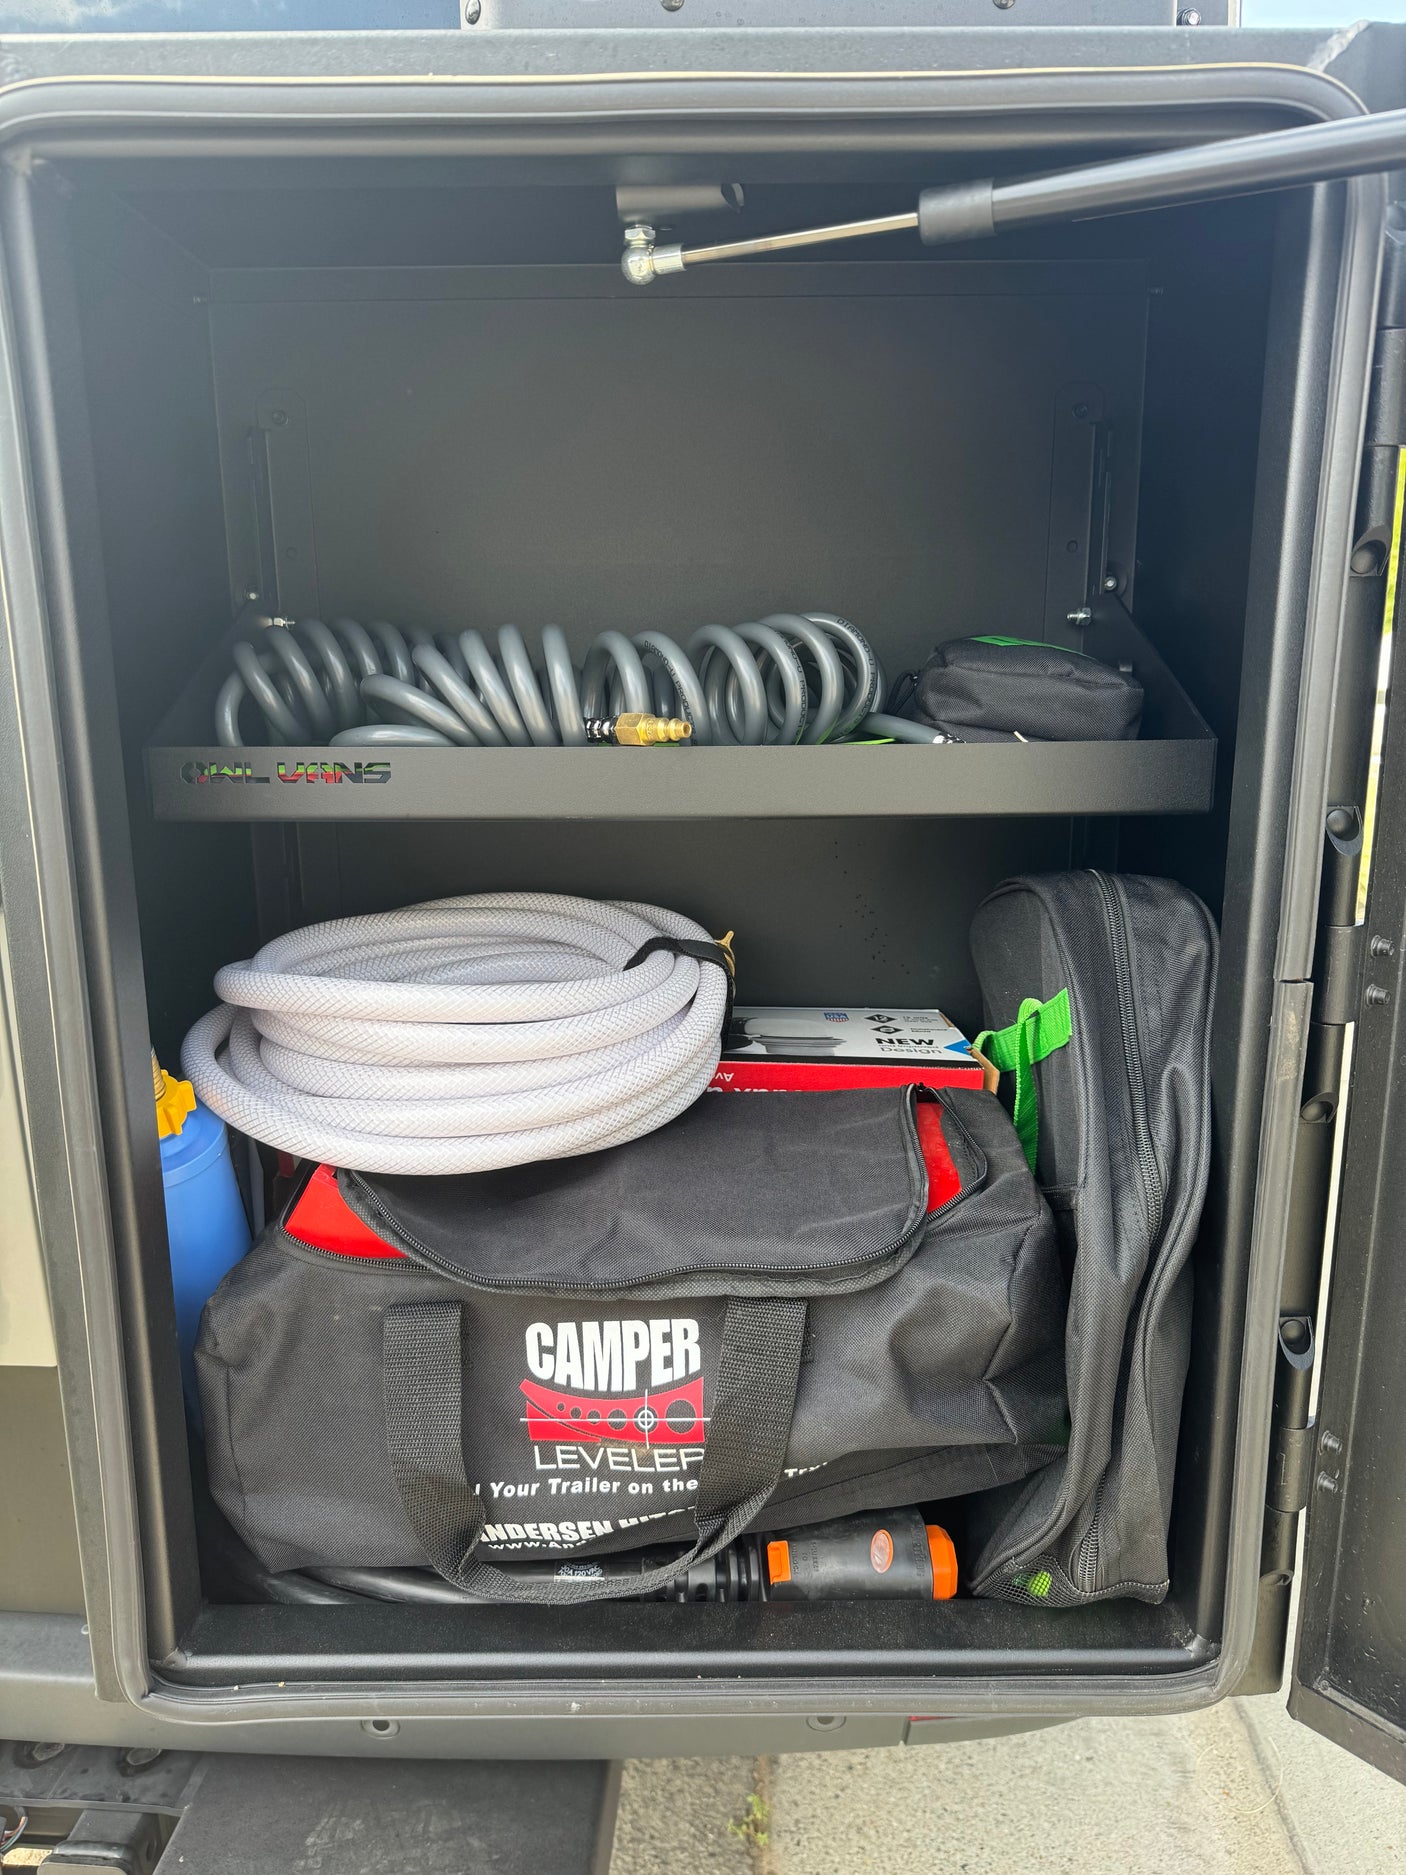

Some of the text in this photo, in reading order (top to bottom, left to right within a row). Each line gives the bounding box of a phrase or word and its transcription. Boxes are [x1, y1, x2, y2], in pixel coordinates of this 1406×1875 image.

[180, 762, 392, 784] OWL VANS
[875, 1038, 935, 1046] NEW
[880, 1047, 943, 1055] Design
[525, 1318, 701, 1392] CAMPER
[492, 1482, 540, 1498] Your
[548, 1478, 620, 1494] Trailer
[628, 1481, 653, 1495] on
[662, 1477, 699, 1493] the
